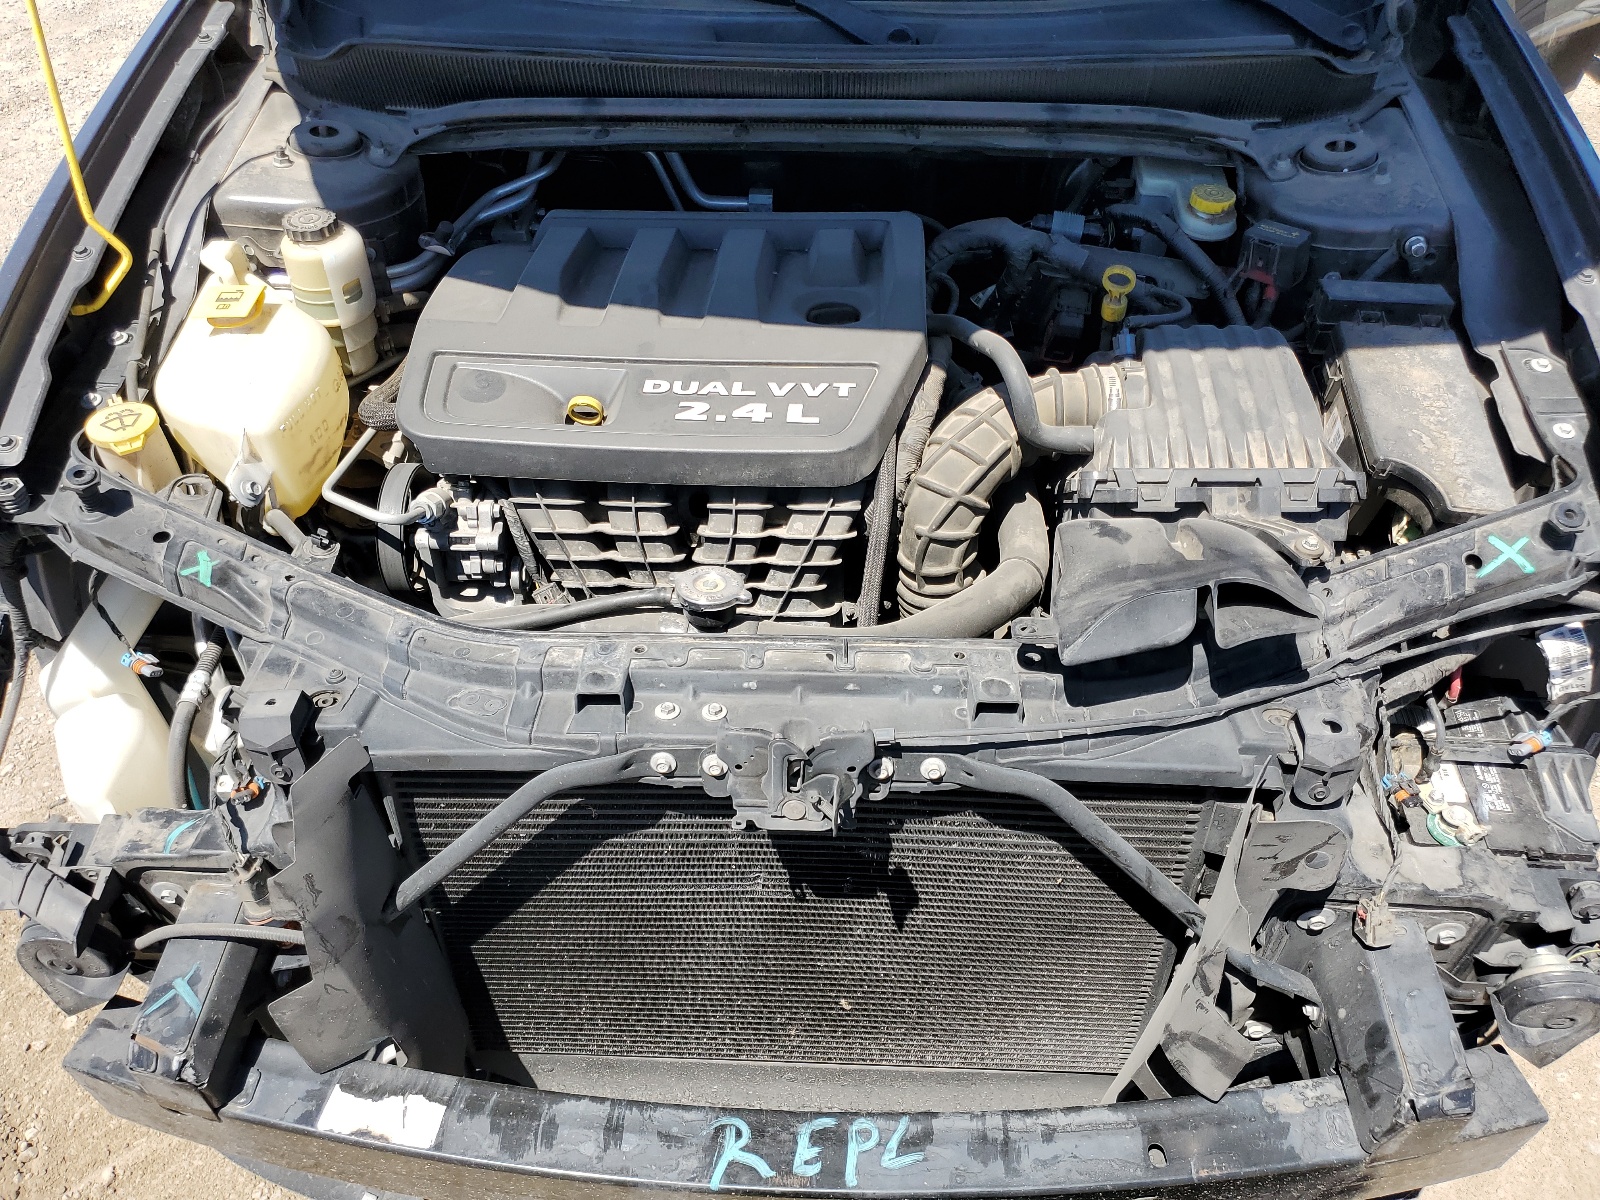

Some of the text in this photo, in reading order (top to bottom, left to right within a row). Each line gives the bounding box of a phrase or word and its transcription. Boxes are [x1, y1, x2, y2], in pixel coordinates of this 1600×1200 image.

[642, 379, 857, 397] DUAL VVT
[674, 401, 820, 424] 2.4 L
[309, 419, 329, 446] ADD
[1475, 534, 1535, 578] X
[700, 1115, 926, 1191] REPL
